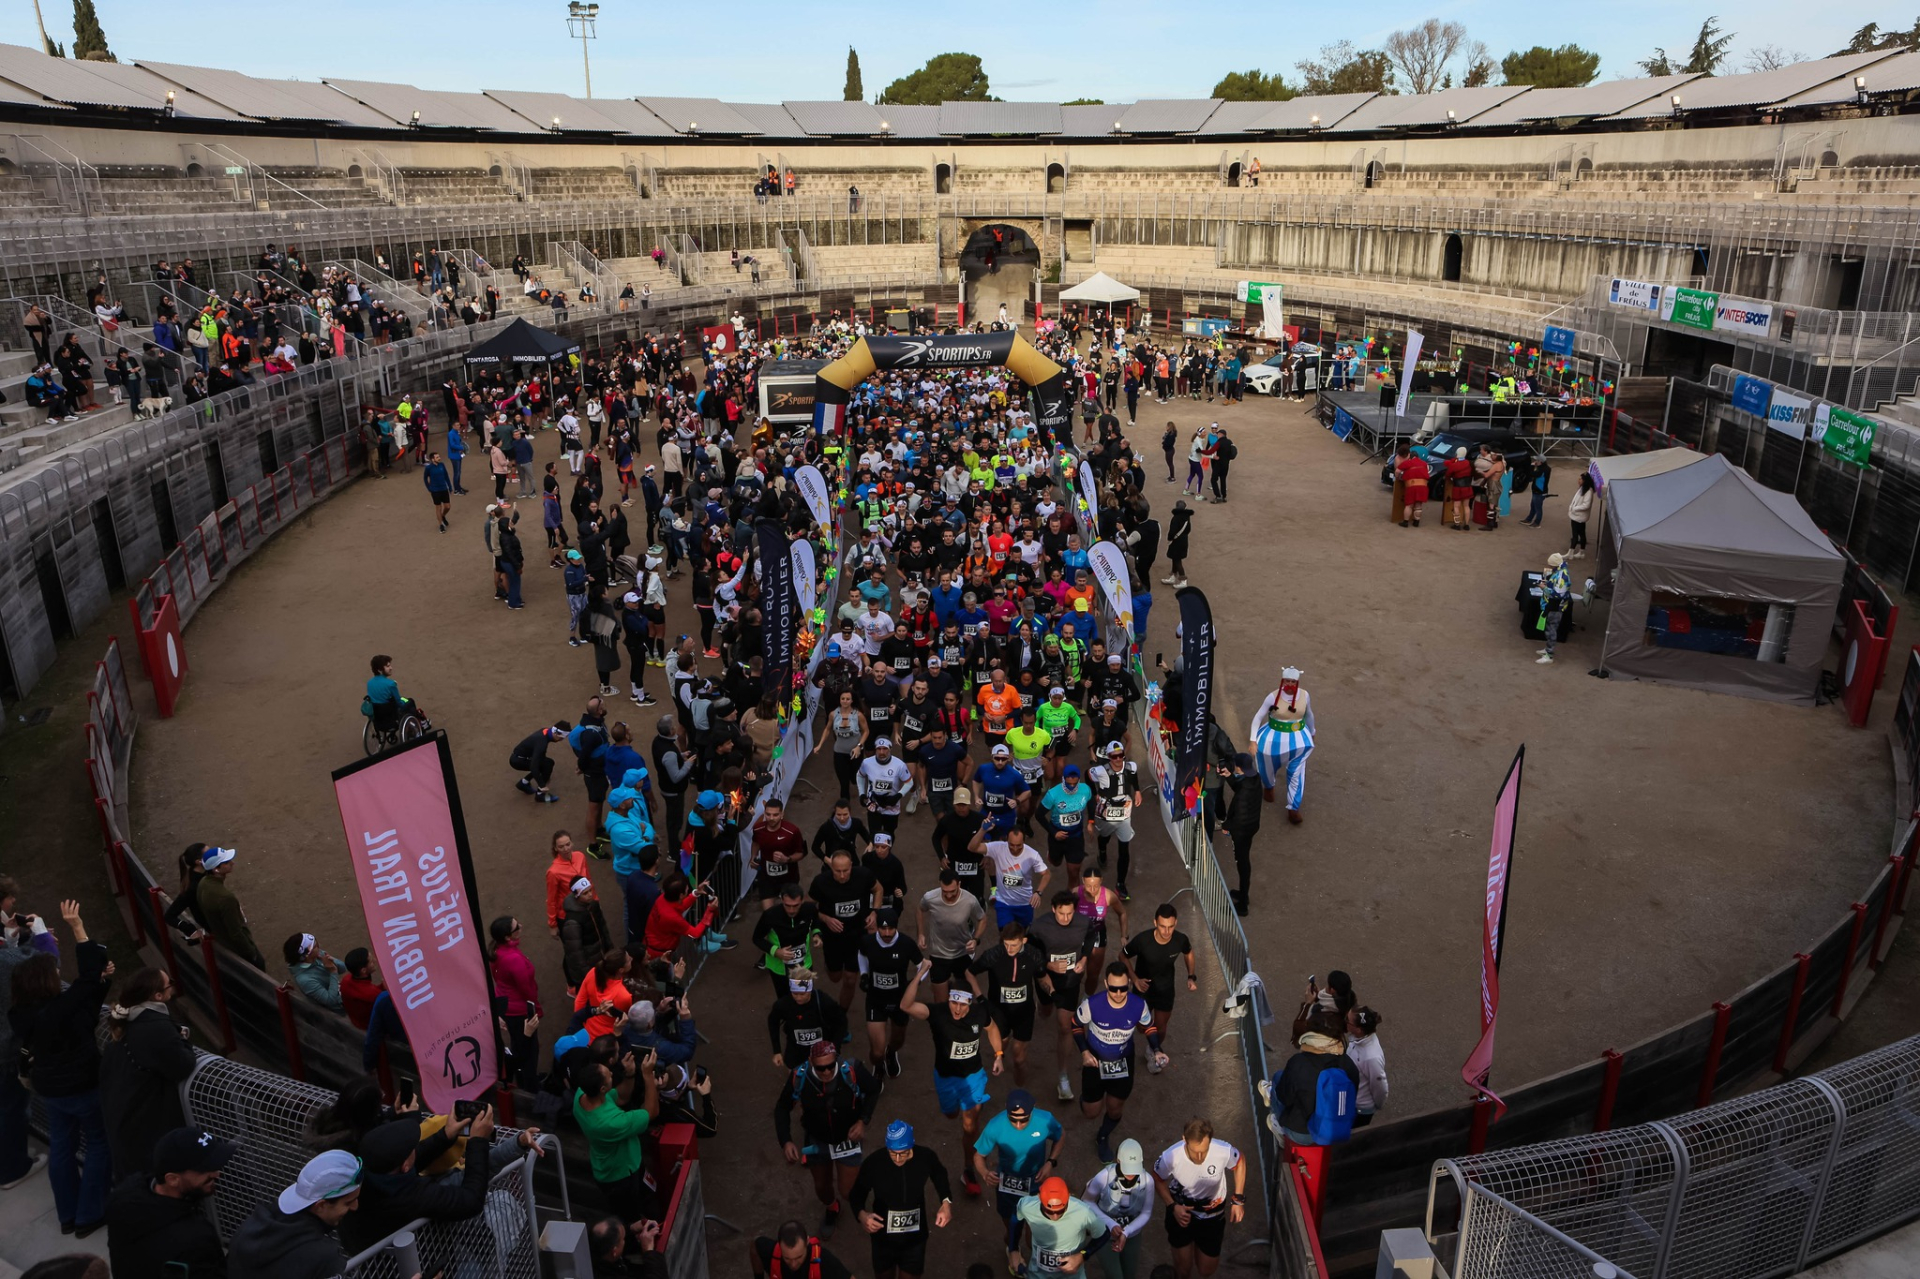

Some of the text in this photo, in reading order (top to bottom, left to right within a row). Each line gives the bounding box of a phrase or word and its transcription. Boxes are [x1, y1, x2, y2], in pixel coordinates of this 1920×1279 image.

[1625, 281, 1647, 289] VILLE
[1629, 289, 1640, 298] de
[1618, 297, 1648, 308] FRÉJUS
[1677, 292, 1703, 305] Carrefour
[1724, 309, 1769, 327] INTERSPORT
[927, 346, 992, 362] SPORTIPS.FR
[466, 355, 500, 363] FONTAROSA
[789, 396, 816, 405] SPORTIP
[1831, 414, 1860, 435] Carrefour
[779, 555, 788, 664] IMMOBILIER
[1193, 621, 1209, 746] IMMOBILIER
[874, 710, 885, 718] 579
[876, 781, 889, 789] 437
[1107, 809, 1121, 817] 480
[1064, 814, 1077, 823] 453
[958, 862, 972, 871] 307
[840, 904, 855, 913] 422
[877, 976, 893, 985] 553
[1005, 991, 1022, 999] 554
[800, 1032, 817, 1041] 398
[956, 1045, 973, 1055] 335
[1104, 1063, 1121, 1073] 134
[1004, 1177, 1024, 1190] 456
[893, 1215, 914, 1227] 394
